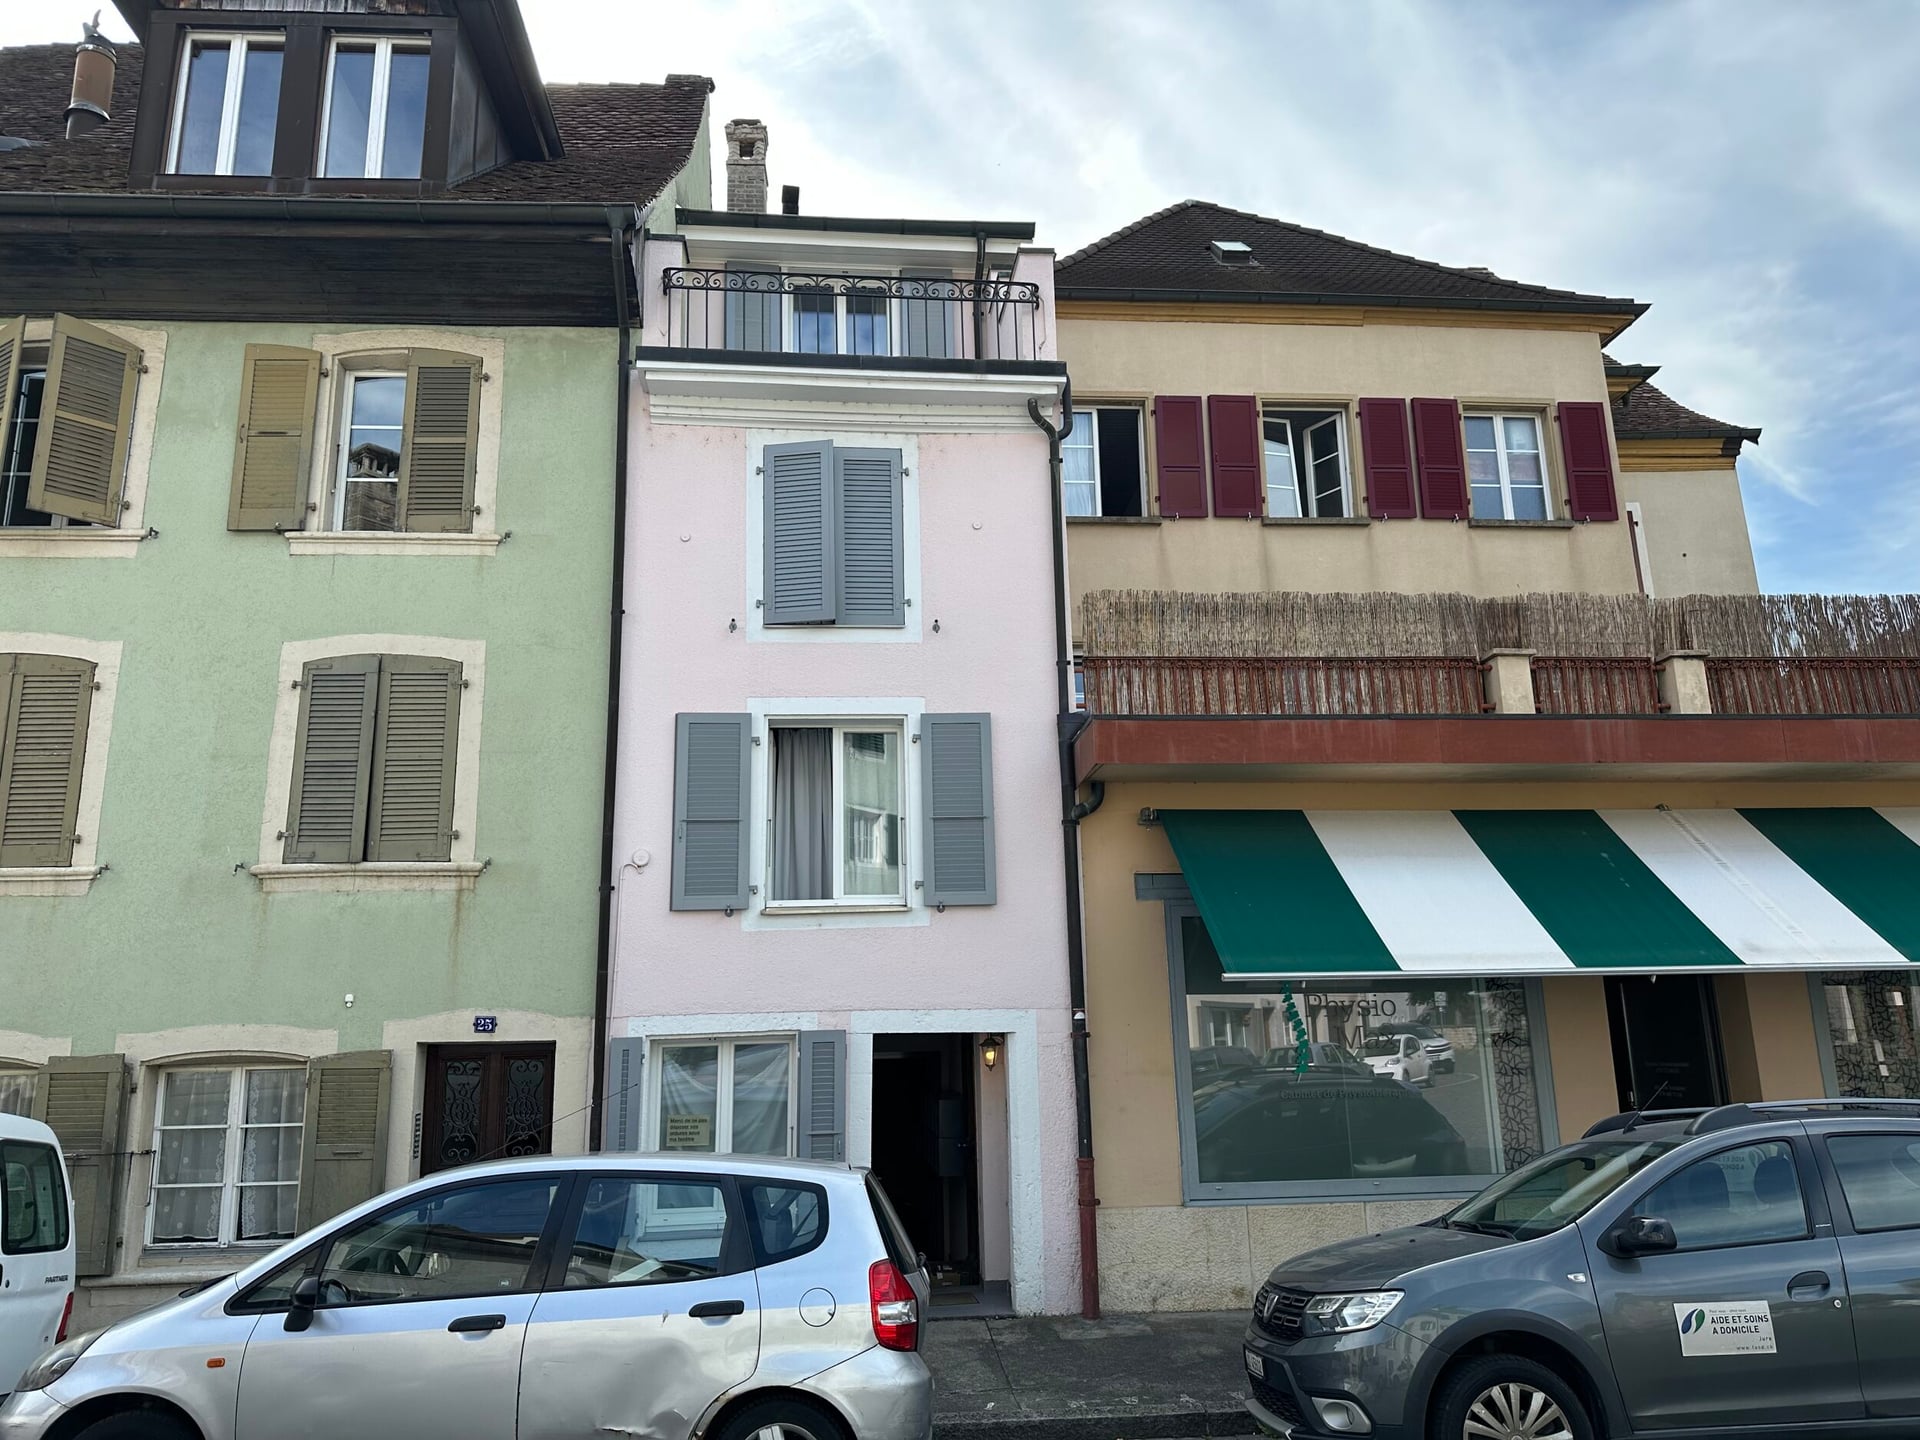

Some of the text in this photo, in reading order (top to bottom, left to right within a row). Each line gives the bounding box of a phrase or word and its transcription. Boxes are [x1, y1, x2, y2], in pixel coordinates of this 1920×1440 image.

[1305, 994, 1396, 1023] Physio
[477, 1018, 493, 1031] 25
[1334, 1026, 1395, 1050] Max
[45, 1275, 68, 1284] PARTNER
[1711, 1314, 1769, 1324] AIDE ET SOINS
[1713, 1325, 1760, 1335] A DOMICILE
